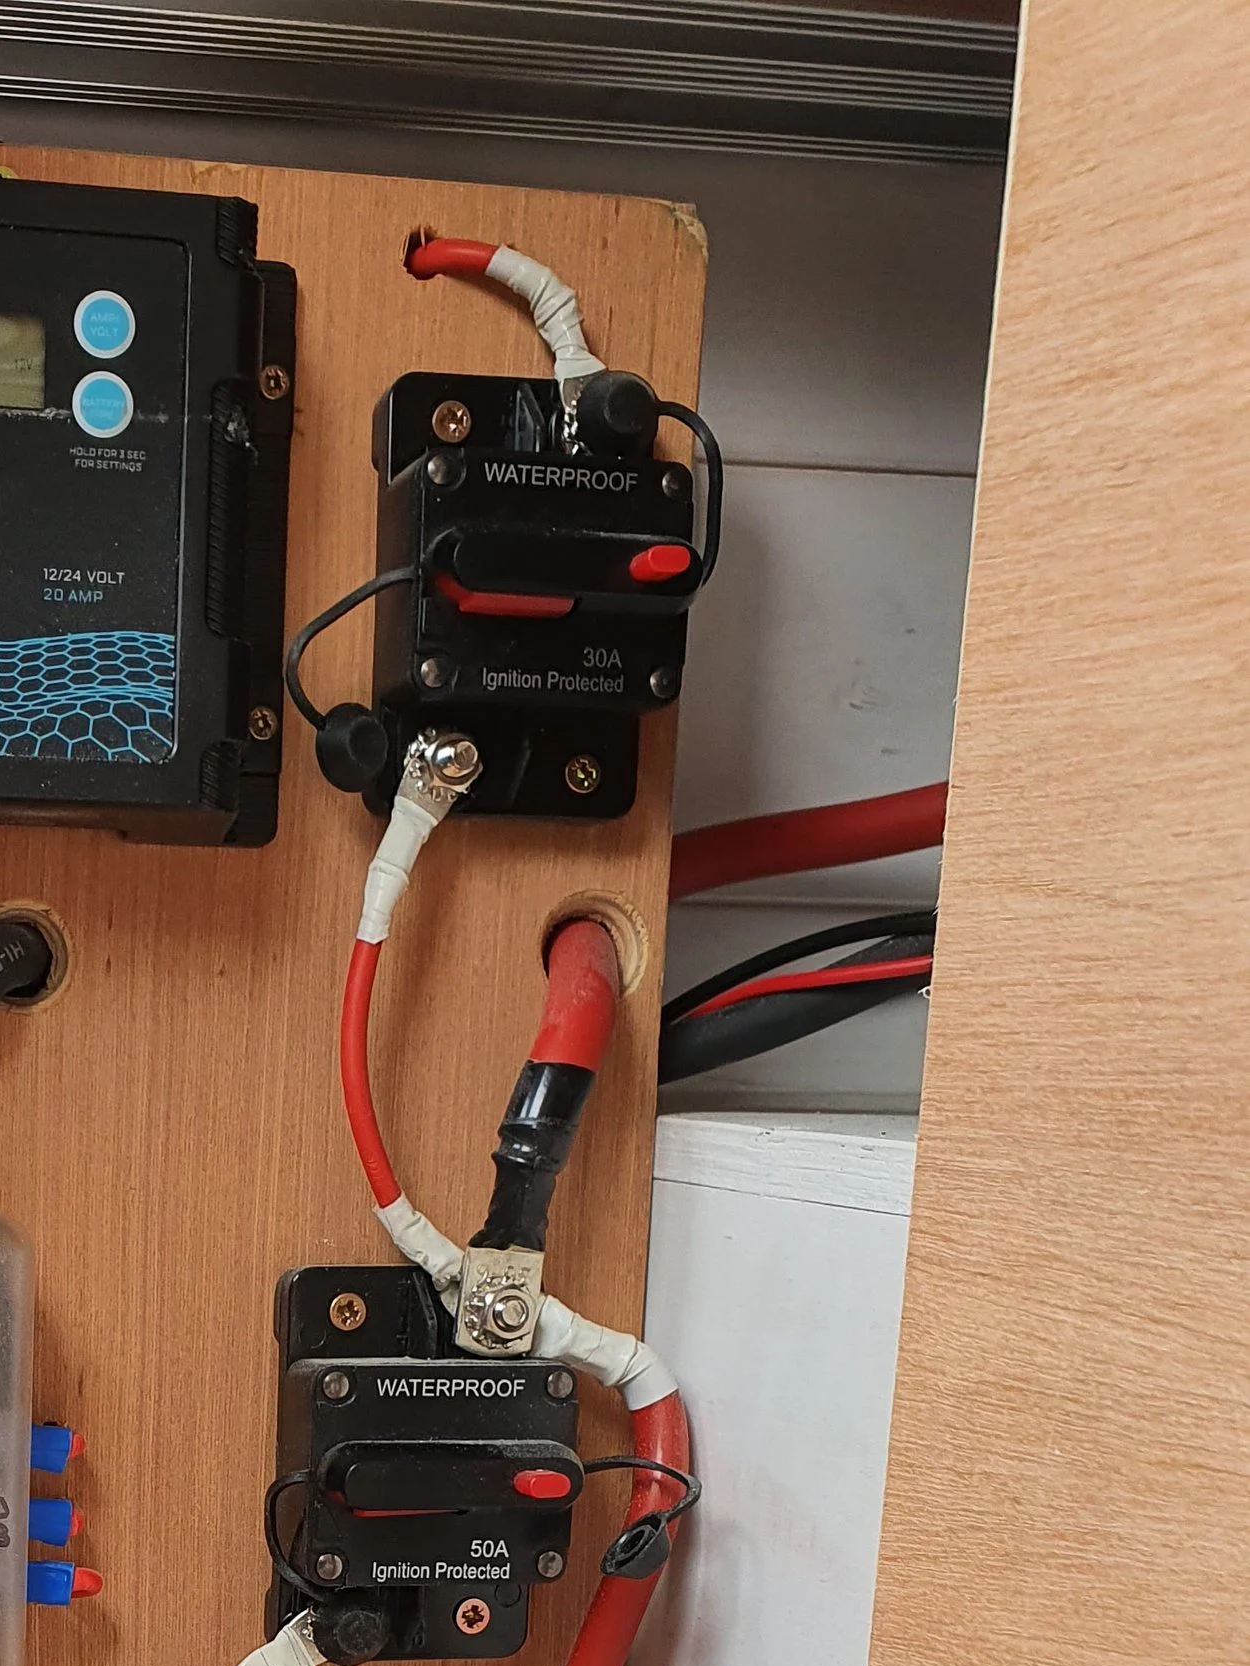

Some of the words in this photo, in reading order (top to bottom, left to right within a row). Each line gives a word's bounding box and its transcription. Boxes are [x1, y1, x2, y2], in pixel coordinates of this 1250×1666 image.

[69, 447, 96, 458] HOLD
[97, 449, 117, 459] FOR
[127, 450, 147, 461] SEC
[75, 458, 95, 469] FOR
[96, 460, 143, 472] SETTINGS
[484, 461, 639, 493] WATERPROOF
[43, 567, 82, 584] 12/24
[86, 568, 125, 585] VOLT
[43, 587, 64, 603] 20
[67, 588, 104, 604] AMP
[583, 647, 622, 669] 30A
[482, 666, 542, 692] Ignition
[547, 670, 625, 694] Protected
[377, 1377, 526, 1399] WATERPROOF
[470, 1540, 510, 1559] 50A
[371, 1561, 430, 1584] Ignition
[434, 1561, 510, 1581] Protected
